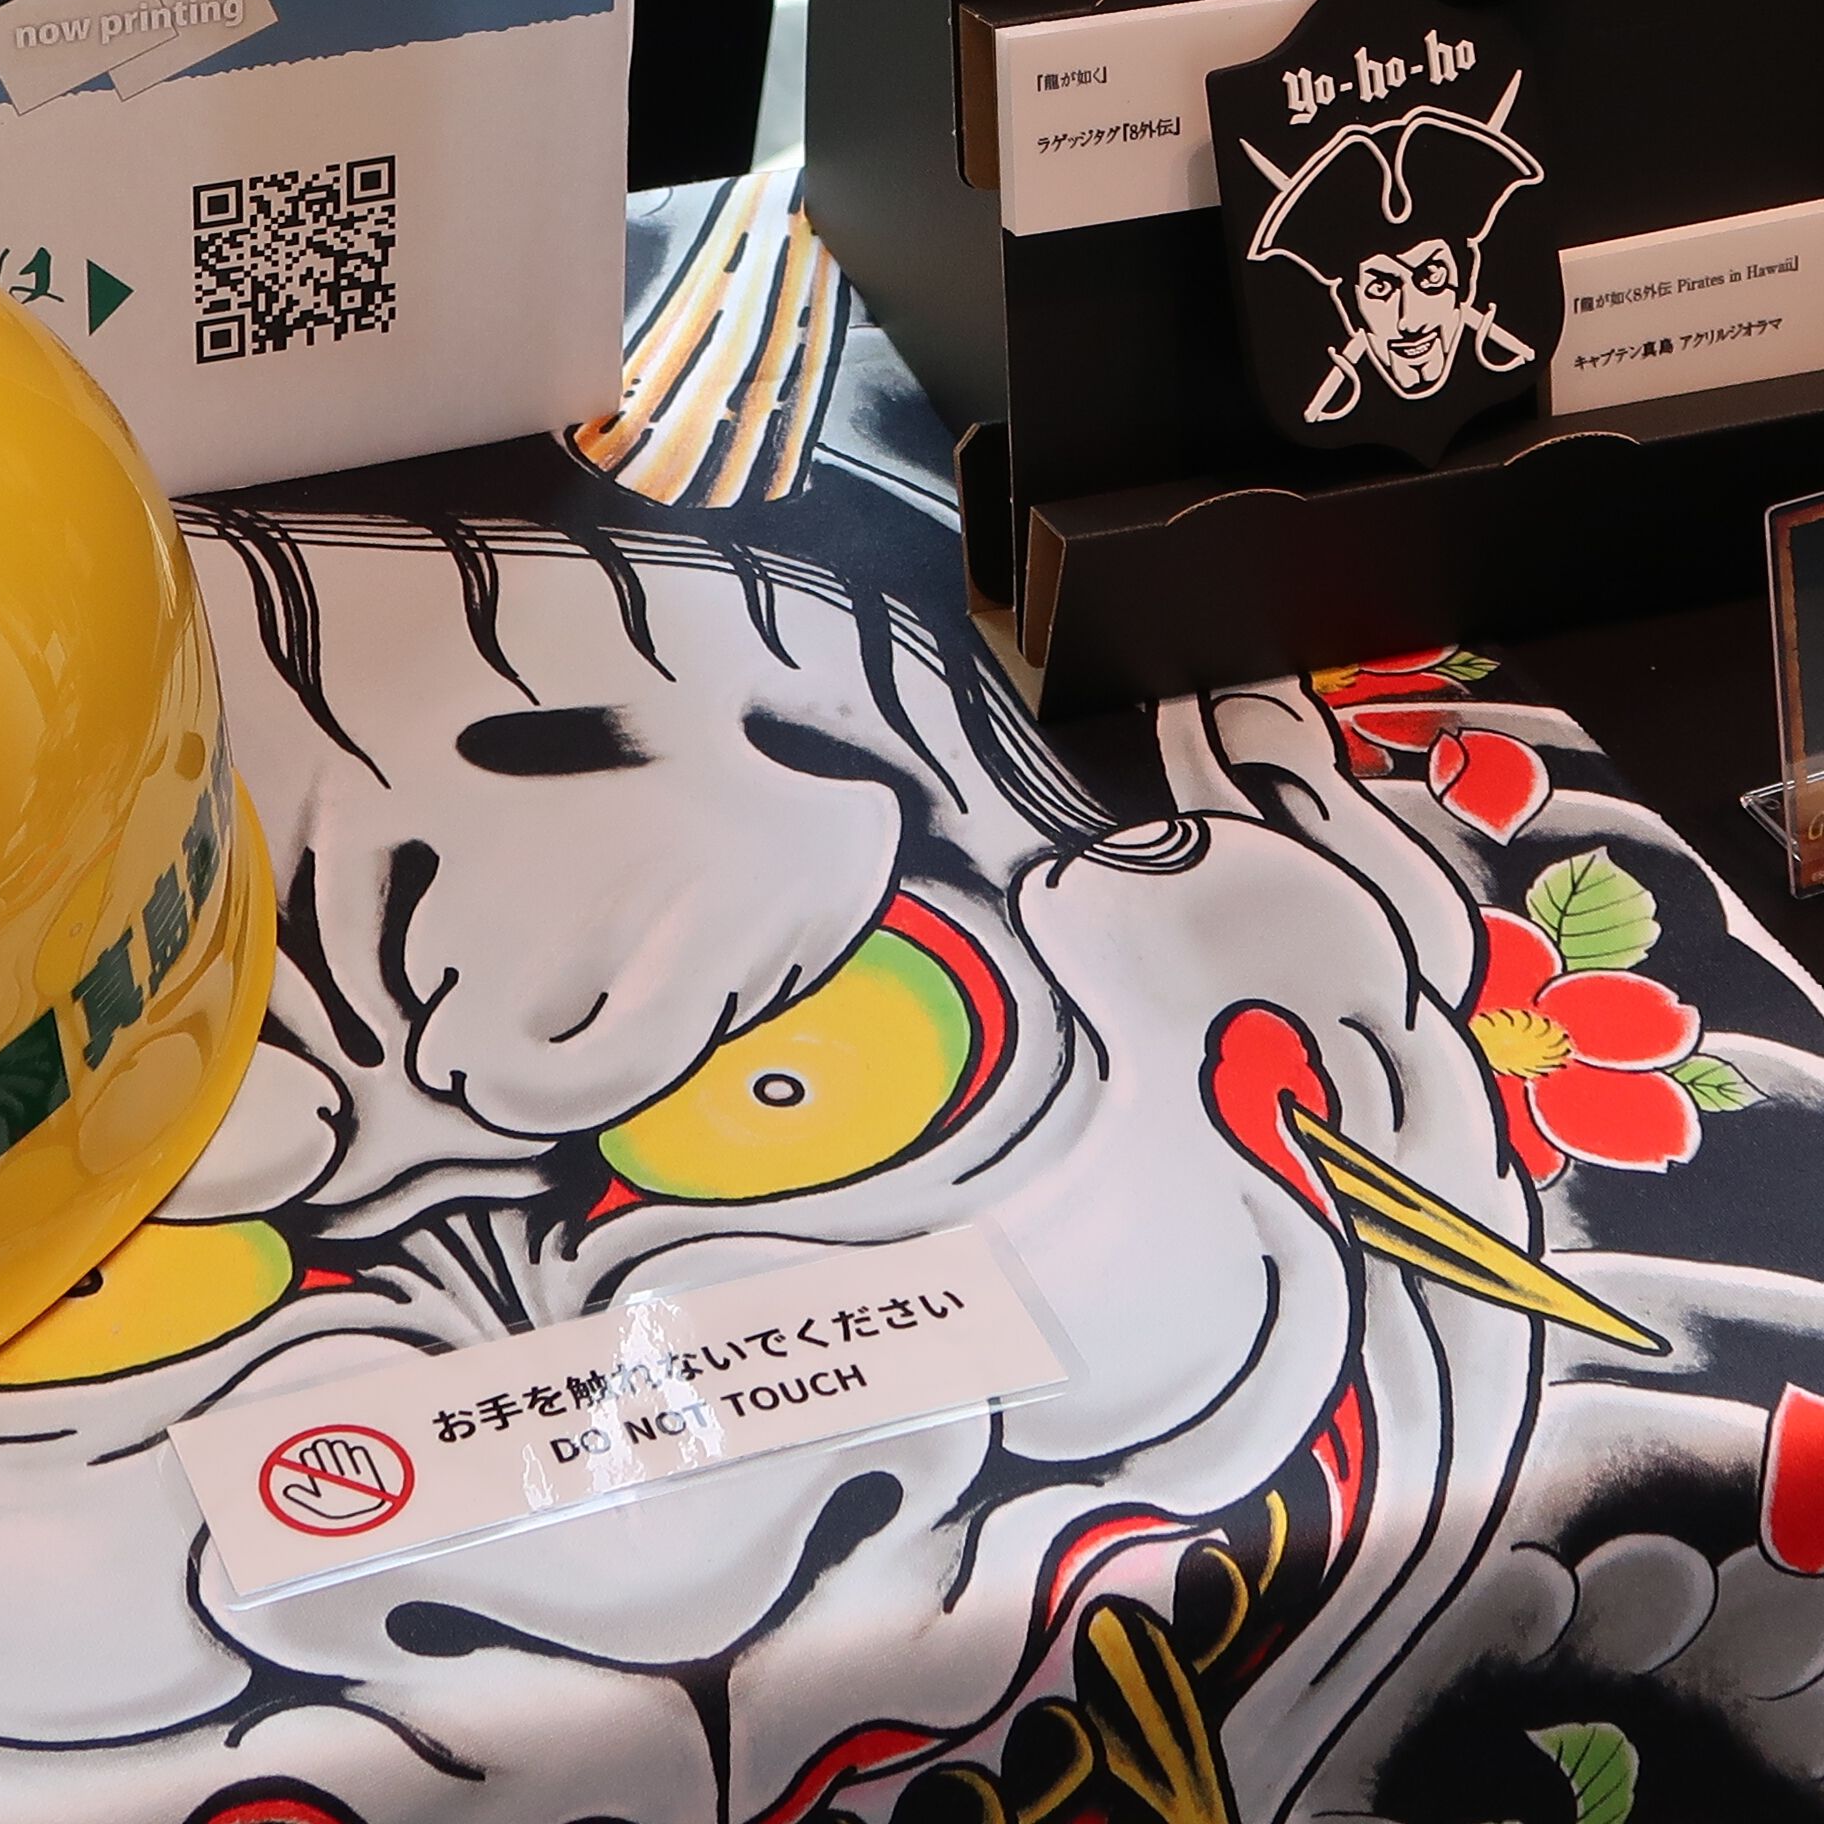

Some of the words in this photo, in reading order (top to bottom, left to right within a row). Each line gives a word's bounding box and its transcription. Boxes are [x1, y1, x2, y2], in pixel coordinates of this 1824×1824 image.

[15, 16, 92, 49] now
[1037, 64, 1108, 93] 『龍が如く』
[1035, 116, 1182, 156] ラゲッジタグ『8外伝』
[1676, 272, 1725, 294] Pirates
[1729, 268, 1741, 287] in
[1573, 337, 1673, 372] キャプテン真島
[1678, 315, 1784, 353] アクリルジオラマ
[432, 1285, 967, 1446] お手を触れないでください
[550, 1425, 609, 1465] DO
[625, 1401, 715, 1444] NOT
[721, 1363, 869, 1421] TOUCH
